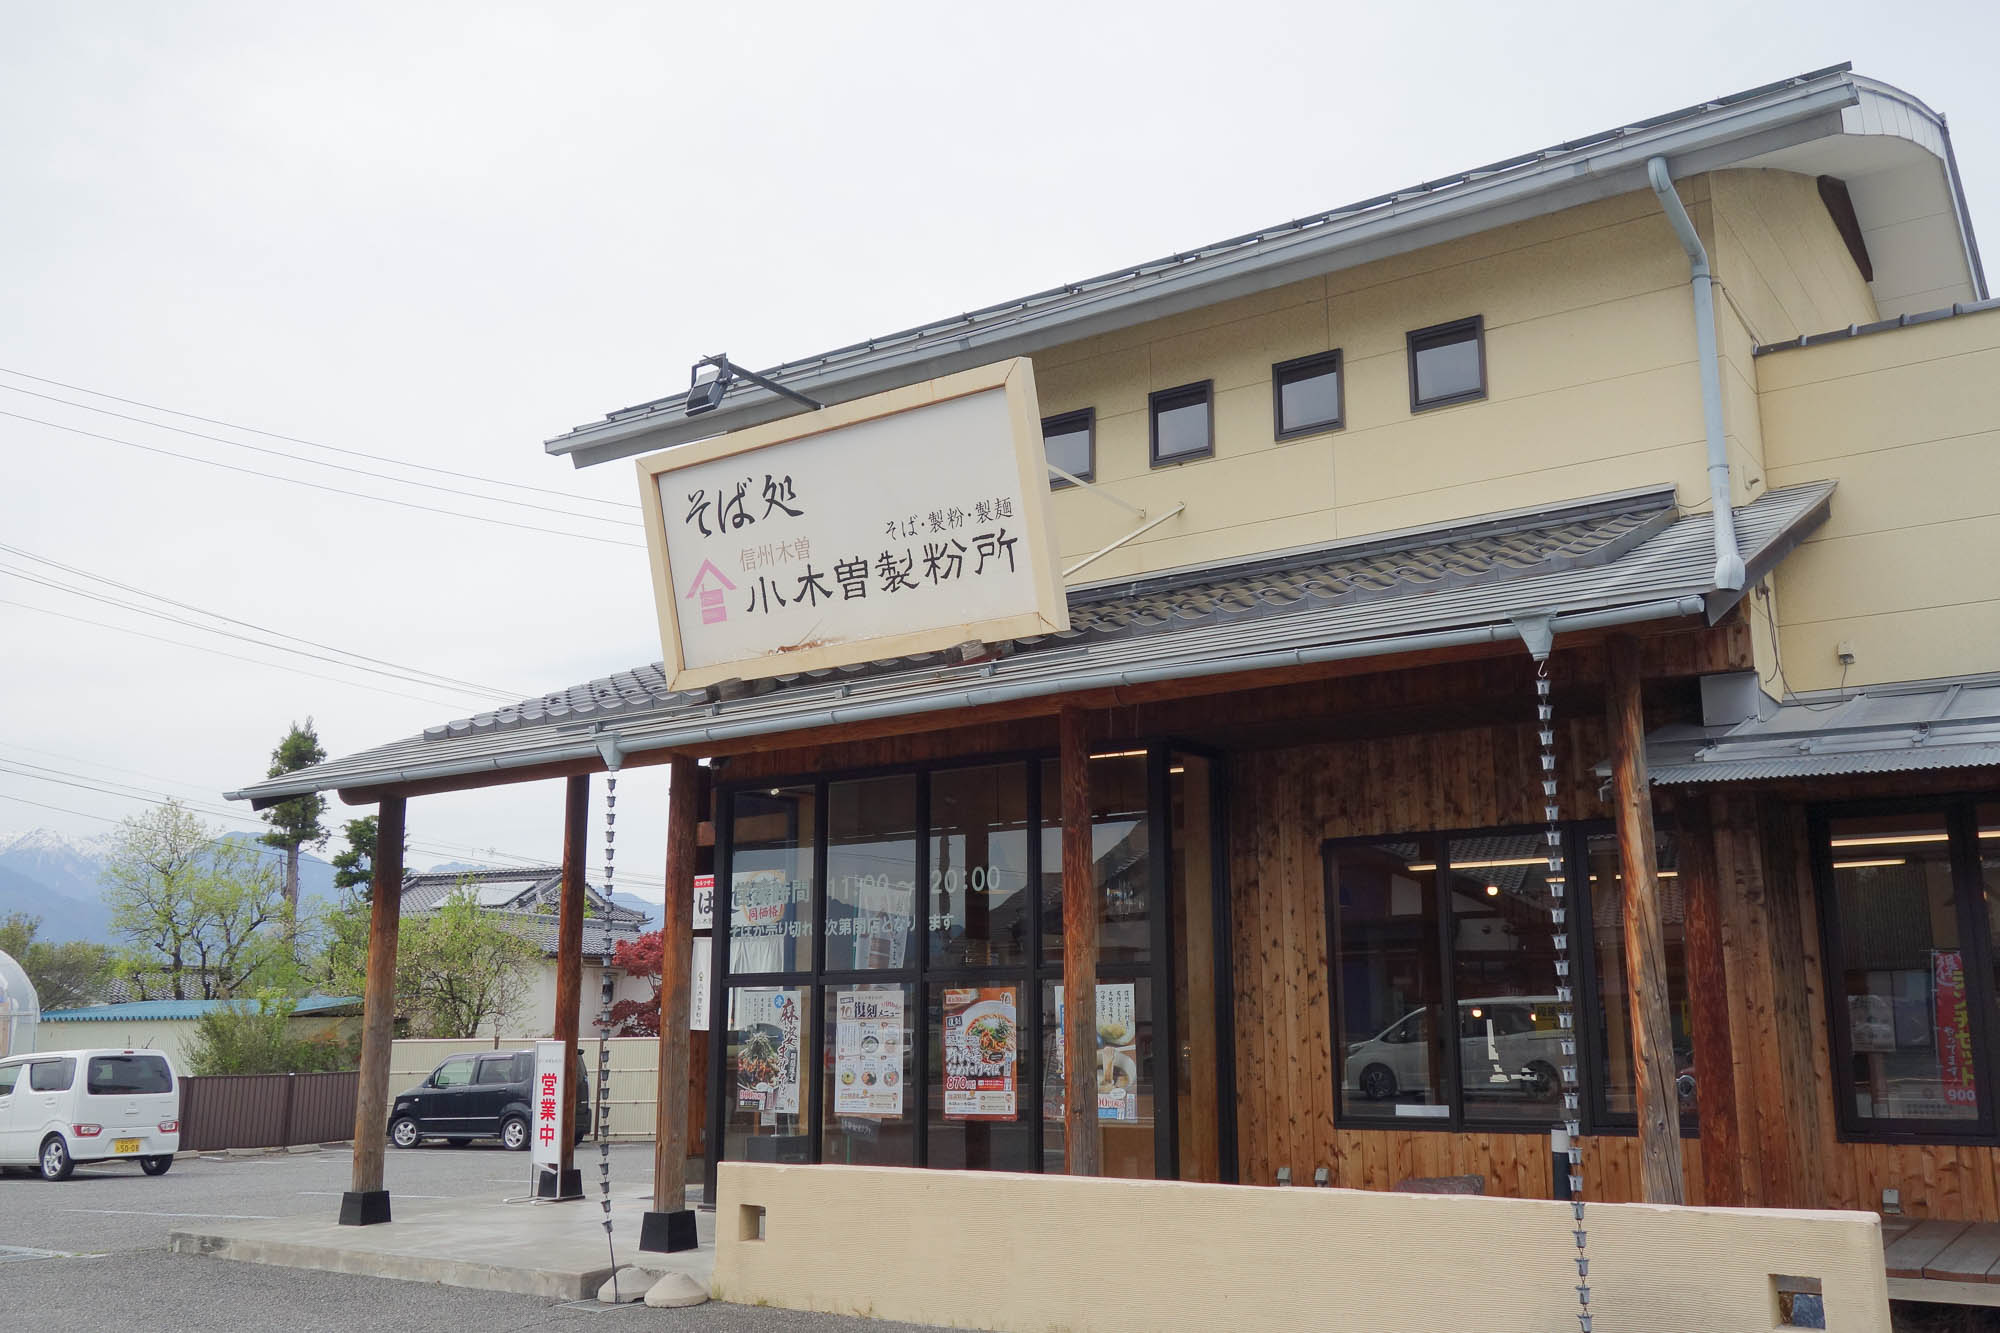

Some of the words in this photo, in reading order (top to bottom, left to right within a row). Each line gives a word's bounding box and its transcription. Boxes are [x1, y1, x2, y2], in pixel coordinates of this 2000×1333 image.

[685, 474, 804, 538] そば処
[885, 496, 1013, 540] そば・製粉・製麺
[739, 537, 811, 571] 信州木曽
[746, 527, 1018, 615] 小木曽製粉所
[931, 866, 1001, 894] 20:00
[929, 913, 954, 932] ます
[540, 1073, 557, 1147] 営業中
